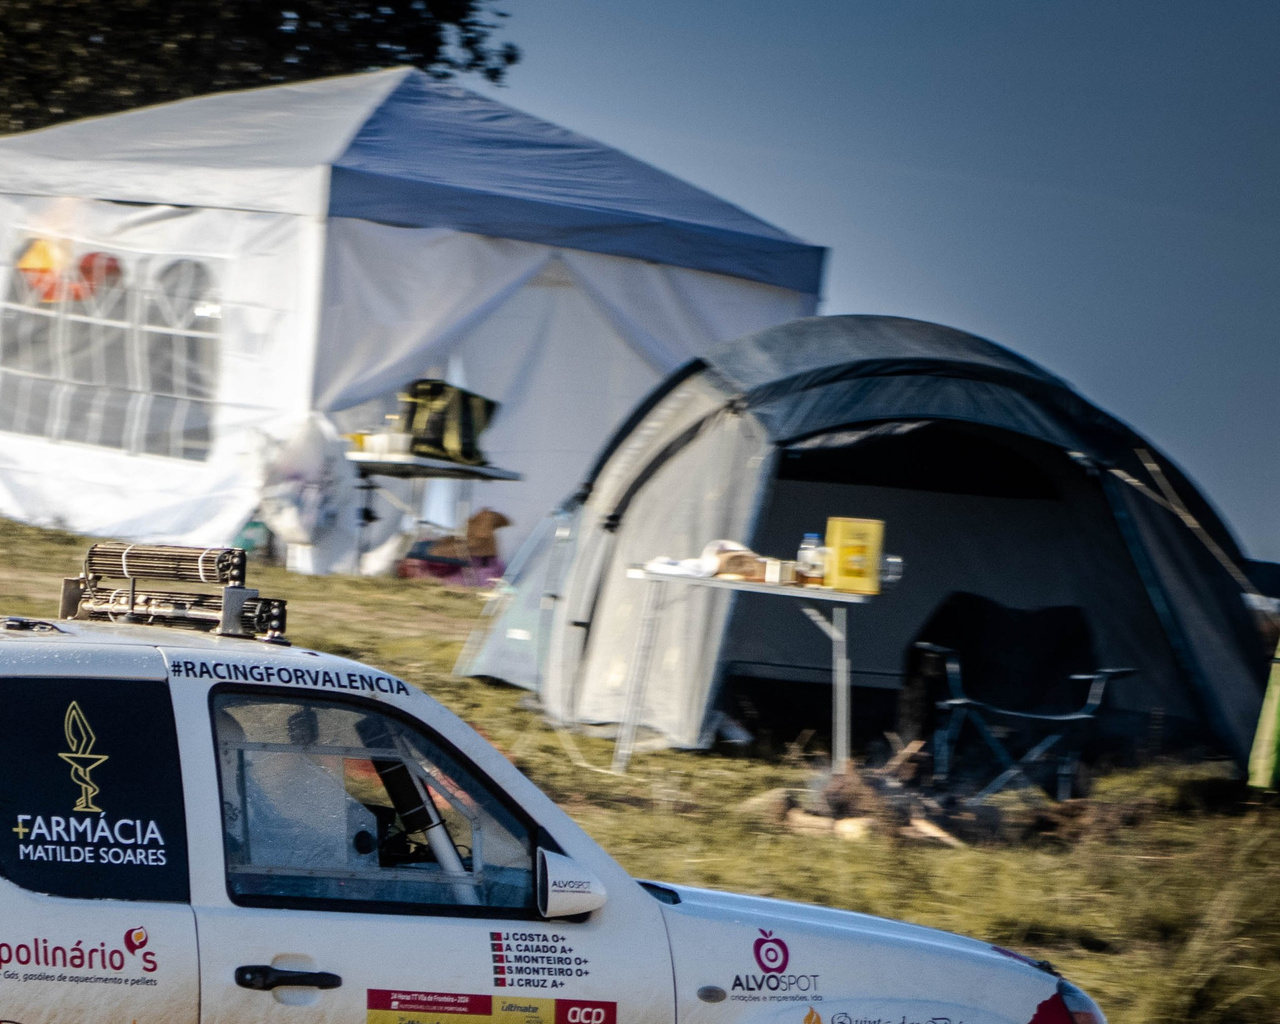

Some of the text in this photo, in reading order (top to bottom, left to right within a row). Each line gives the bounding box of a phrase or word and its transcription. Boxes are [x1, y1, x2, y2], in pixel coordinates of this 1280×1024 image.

[170, 660, 411, 696] #RACINGFORVALENCIA
[12, 811, 165, 846] FARMÁCIA
[19, 844, 167, 866] MATILDE SOARES
[57, 973, 67, 981] de
[731, 974, 820, 991] ALVOSPOT
